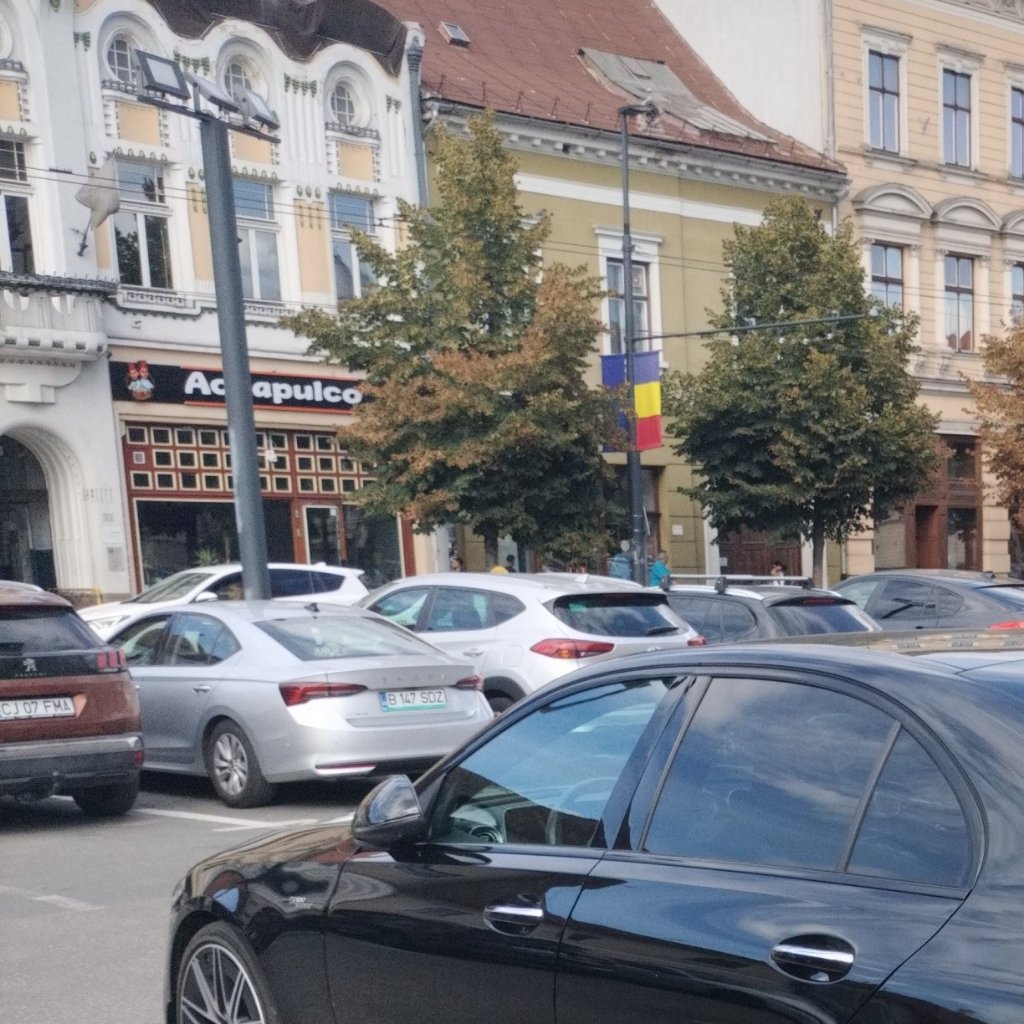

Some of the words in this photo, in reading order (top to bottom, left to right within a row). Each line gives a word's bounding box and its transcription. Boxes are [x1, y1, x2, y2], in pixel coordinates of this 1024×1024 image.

[388, 694, 397, 706] B
[400, 692, 416, 705] 147
[420, 691, 444, 704] SDZ
[1, 702, 19, 716] CJ
[23, 701, 38, 714] 07
[43, 700, 72, 713] FMA
